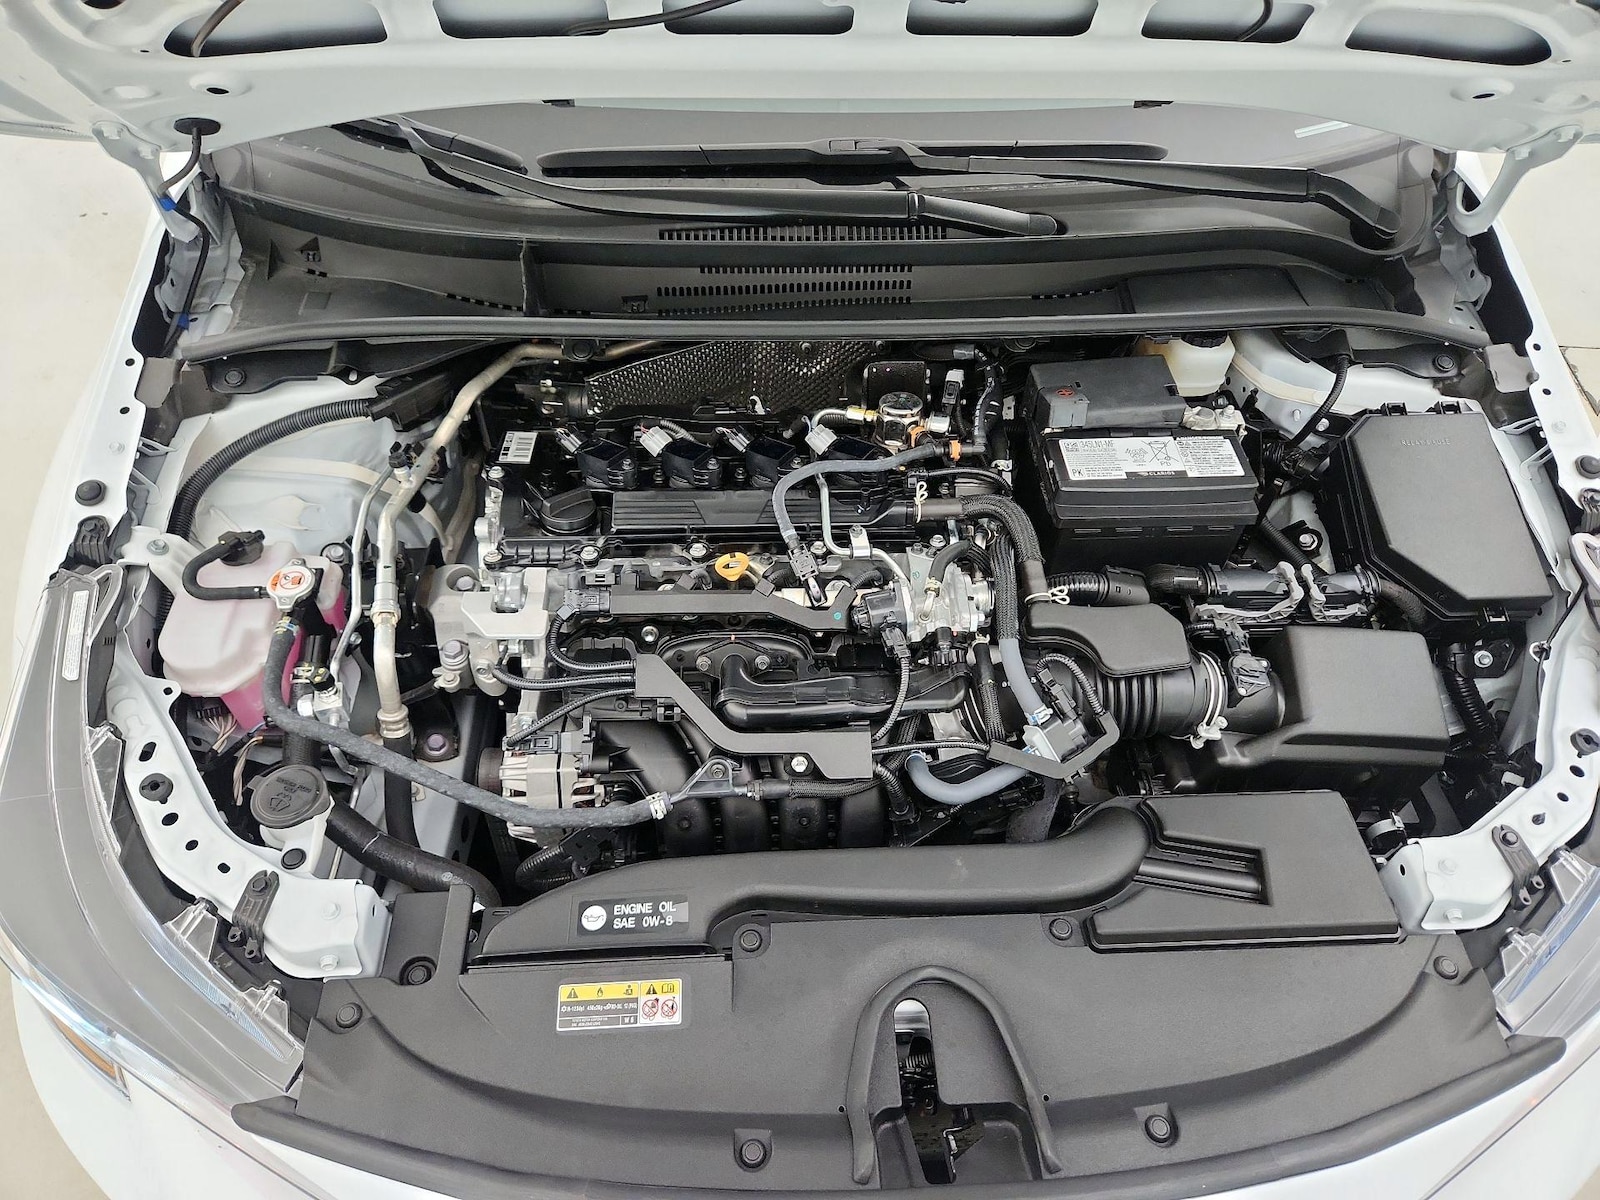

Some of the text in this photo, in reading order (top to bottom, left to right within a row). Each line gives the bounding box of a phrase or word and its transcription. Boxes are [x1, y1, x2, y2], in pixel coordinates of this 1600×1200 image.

[1071, 468, 1084, 477] PK
[613, 901, 677, 915] ENGINE OIL
[612, 916, 636, 929] SAE
